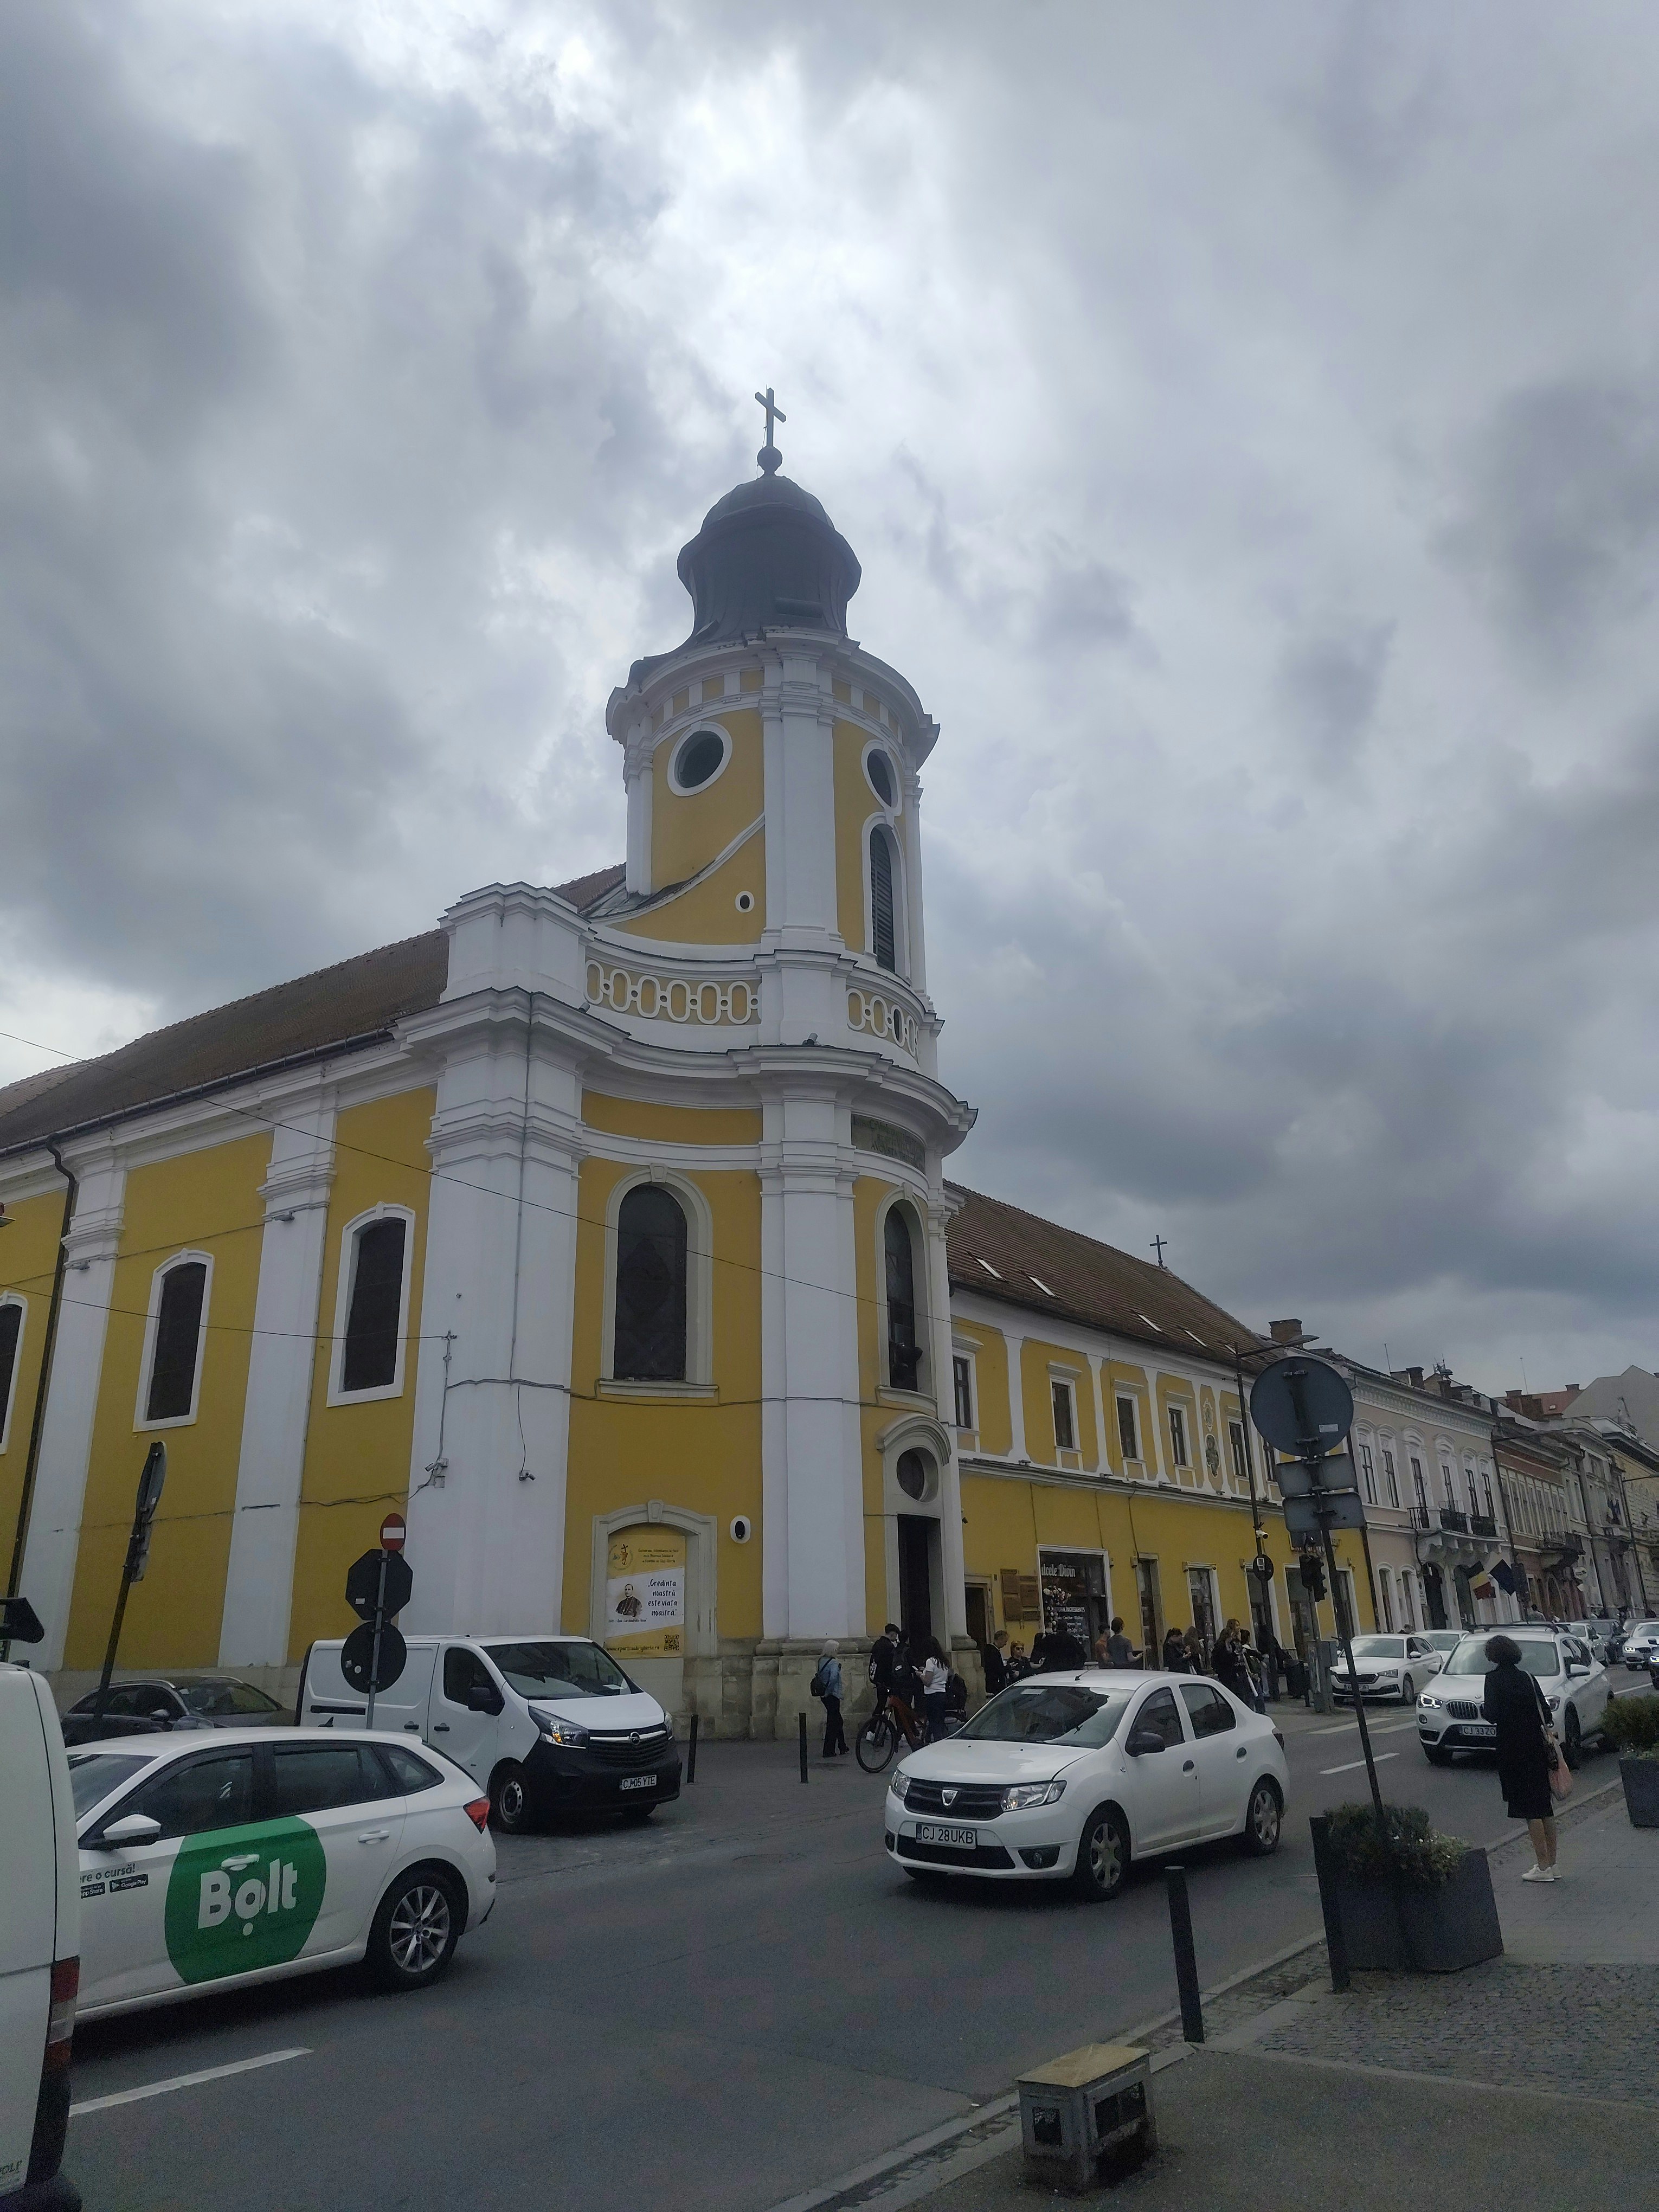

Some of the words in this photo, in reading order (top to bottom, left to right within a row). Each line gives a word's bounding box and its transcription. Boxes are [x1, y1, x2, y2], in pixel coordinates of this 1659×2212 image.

[643, 1776, 655, 1785] YTE
[923, 1827, 935, 1840] CJ
[80, 1874, 93, 1883] re
[95, 1872, 102, 1880] o
[104, 1863, 136, 1879] cursă!
[198, 1858, 298, 1933] Bolt
